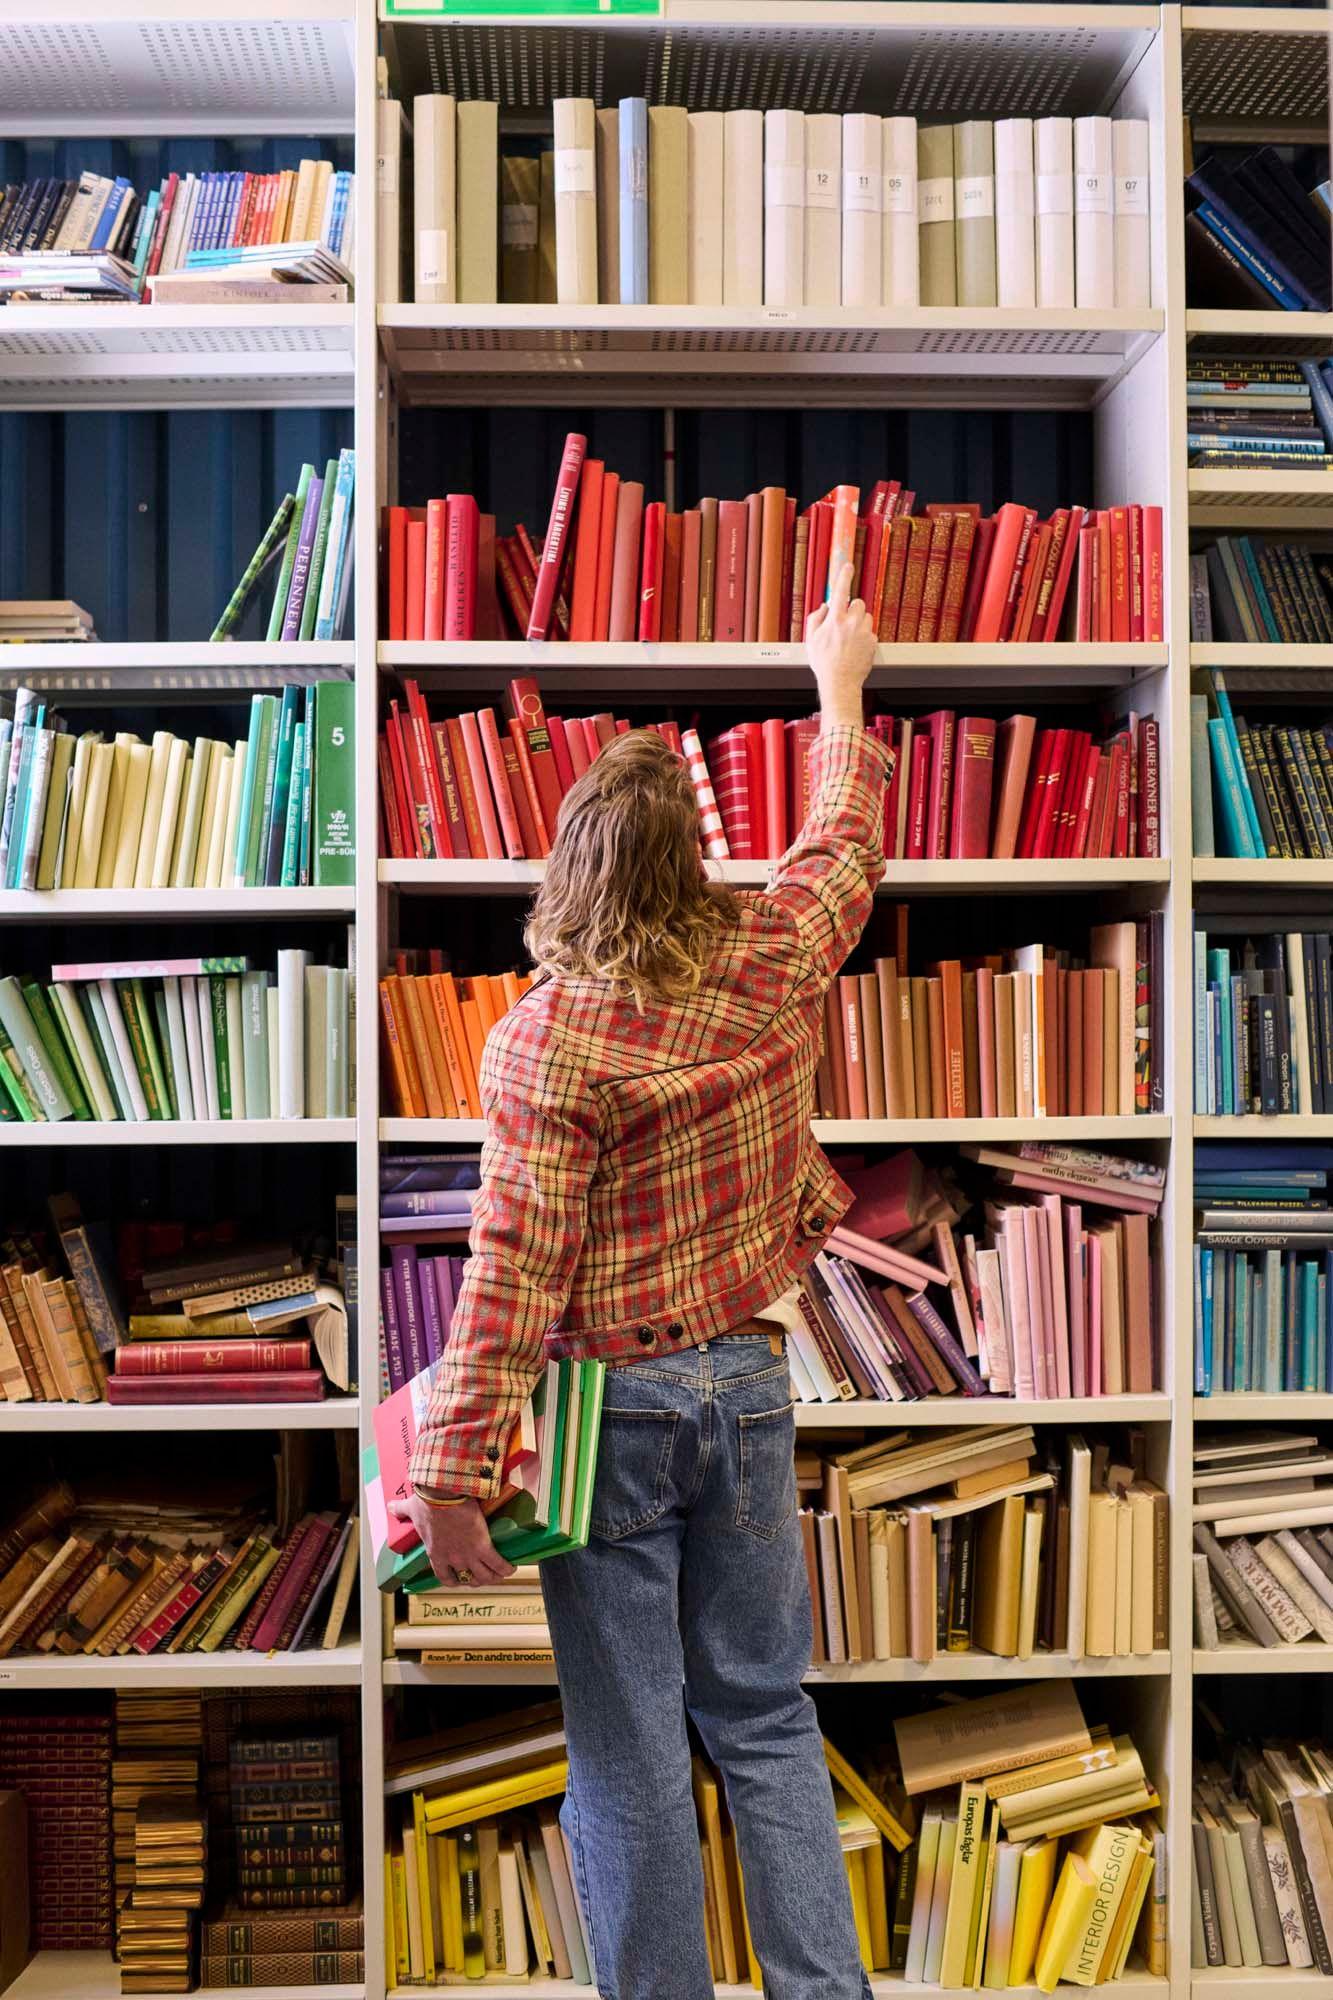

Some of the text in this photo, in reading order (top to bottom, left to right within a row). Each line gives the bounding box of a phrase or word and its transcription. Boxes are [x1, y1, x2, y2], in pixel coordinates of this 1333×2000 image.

[817, 174, 828, 184] 12
[859, 175, 869, 186] 11
[889, 178, 902, 188] 05
[1087, 179, 1098, 190] 01
[1125, 180, 1137, 190] 07
[287, 545, 310, 629] PERENNER
[331, 727, 344, 745] 5
[1145, 722, 1157, 766] CLAIRE
[1145, 767, 1157, 813] RAYNER
[1117, 790, 1128, 817] Guide
[1280, 1052, 1290, 1109] Ocean Depths
[1042, 1166, 1066, 1177] earthy
[1207, 1235, 1288, 1244] SAVAGE ODYSSEY
[400, 1416, 411, 1458] identitet
[422, 1602, 458, 1617] DONNA
[459, 1603, 495, 1617] TARTT
[1244, 1562, 1301, 1637] SUMMER
[464, 1652, 483, 1661] Den
[484, 1652, 512, 1661] andre
[513, 1651, 552, 1661] brodern
[960, 1796, 978, 1864] Europas fåglar
[1078, 1832, 1130, 1976] INTERIOR DESIGN
[1201, 1888, 1218, 1959] Crystal Vision
